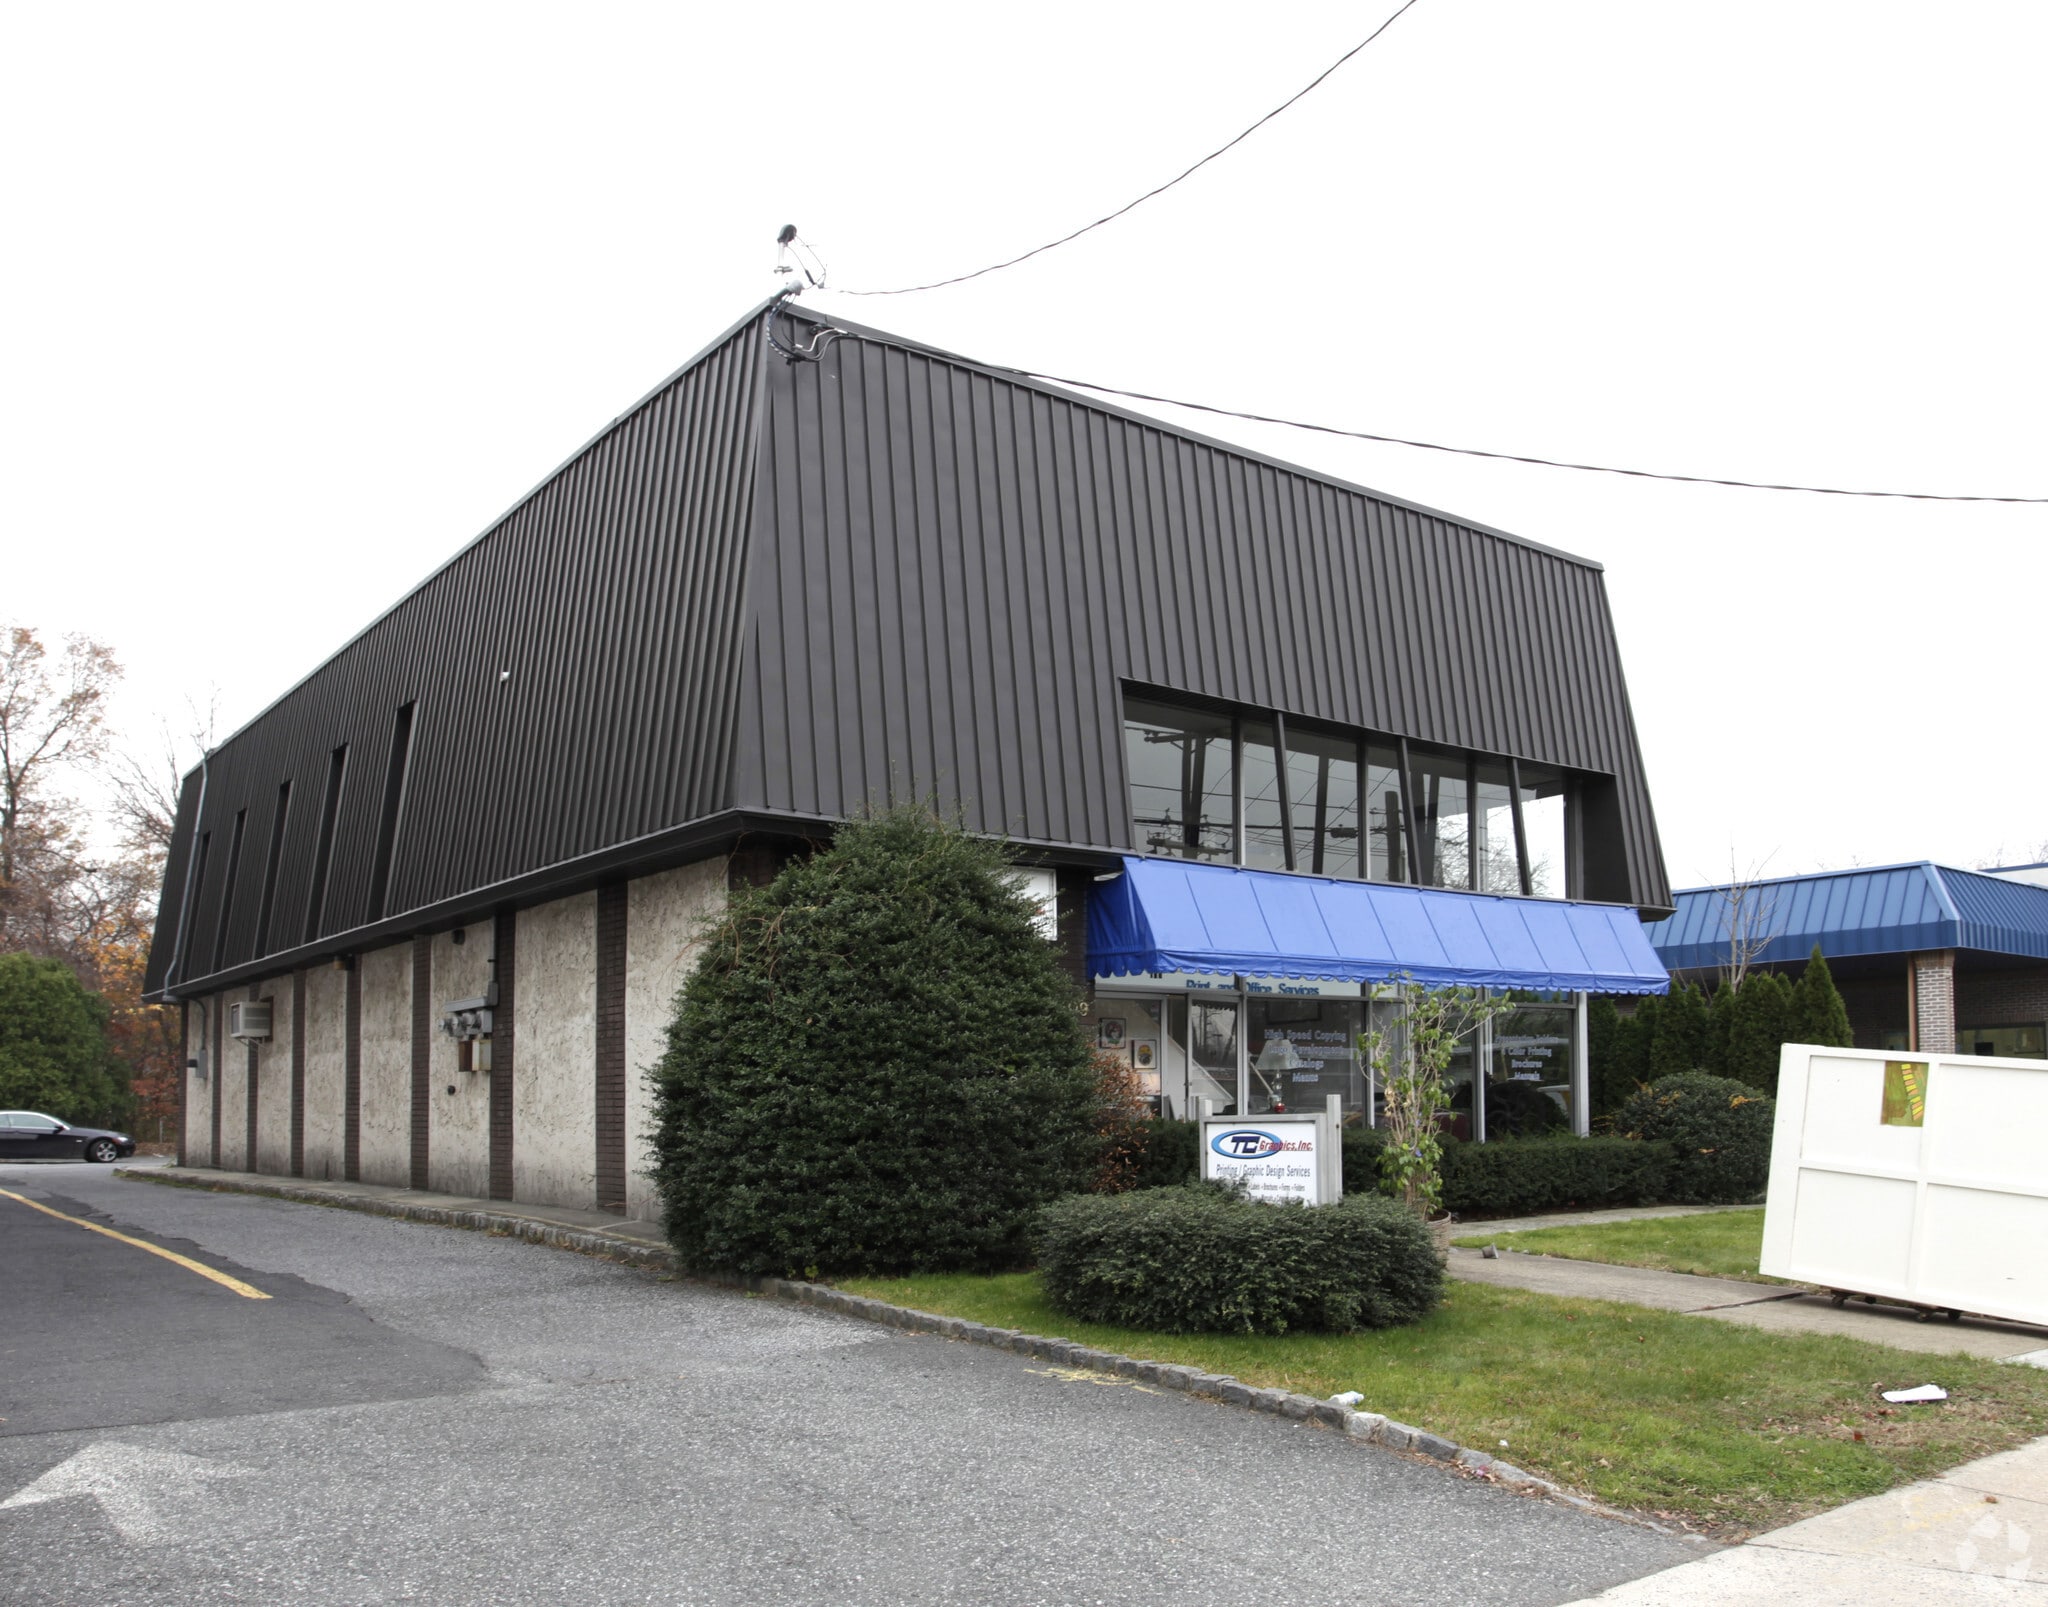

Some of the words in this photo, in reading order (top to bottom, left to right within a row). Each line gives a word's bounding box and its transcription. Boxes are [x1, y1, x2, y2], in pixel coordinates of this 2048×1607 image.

[1186, 979, 1211, 988] Print
[1278, 983, 1320, 995] Services
[1264, 1029, 1284, 1039] High
[1287, 1029, 1312, 1041] Speed
[1314, 1030, 1347, 1042] Copying
[1527, 1047, 1552, 1057] Printing
[1231, 1136, 1260, 1154] TC
[1216, 1164, 1238, 1177] Printing
[1243, 1164, 1265, 1179] Graphic
[1266, 1164, 1285, 1179] Design
[1287, 1165, 1311, 1178] Services
